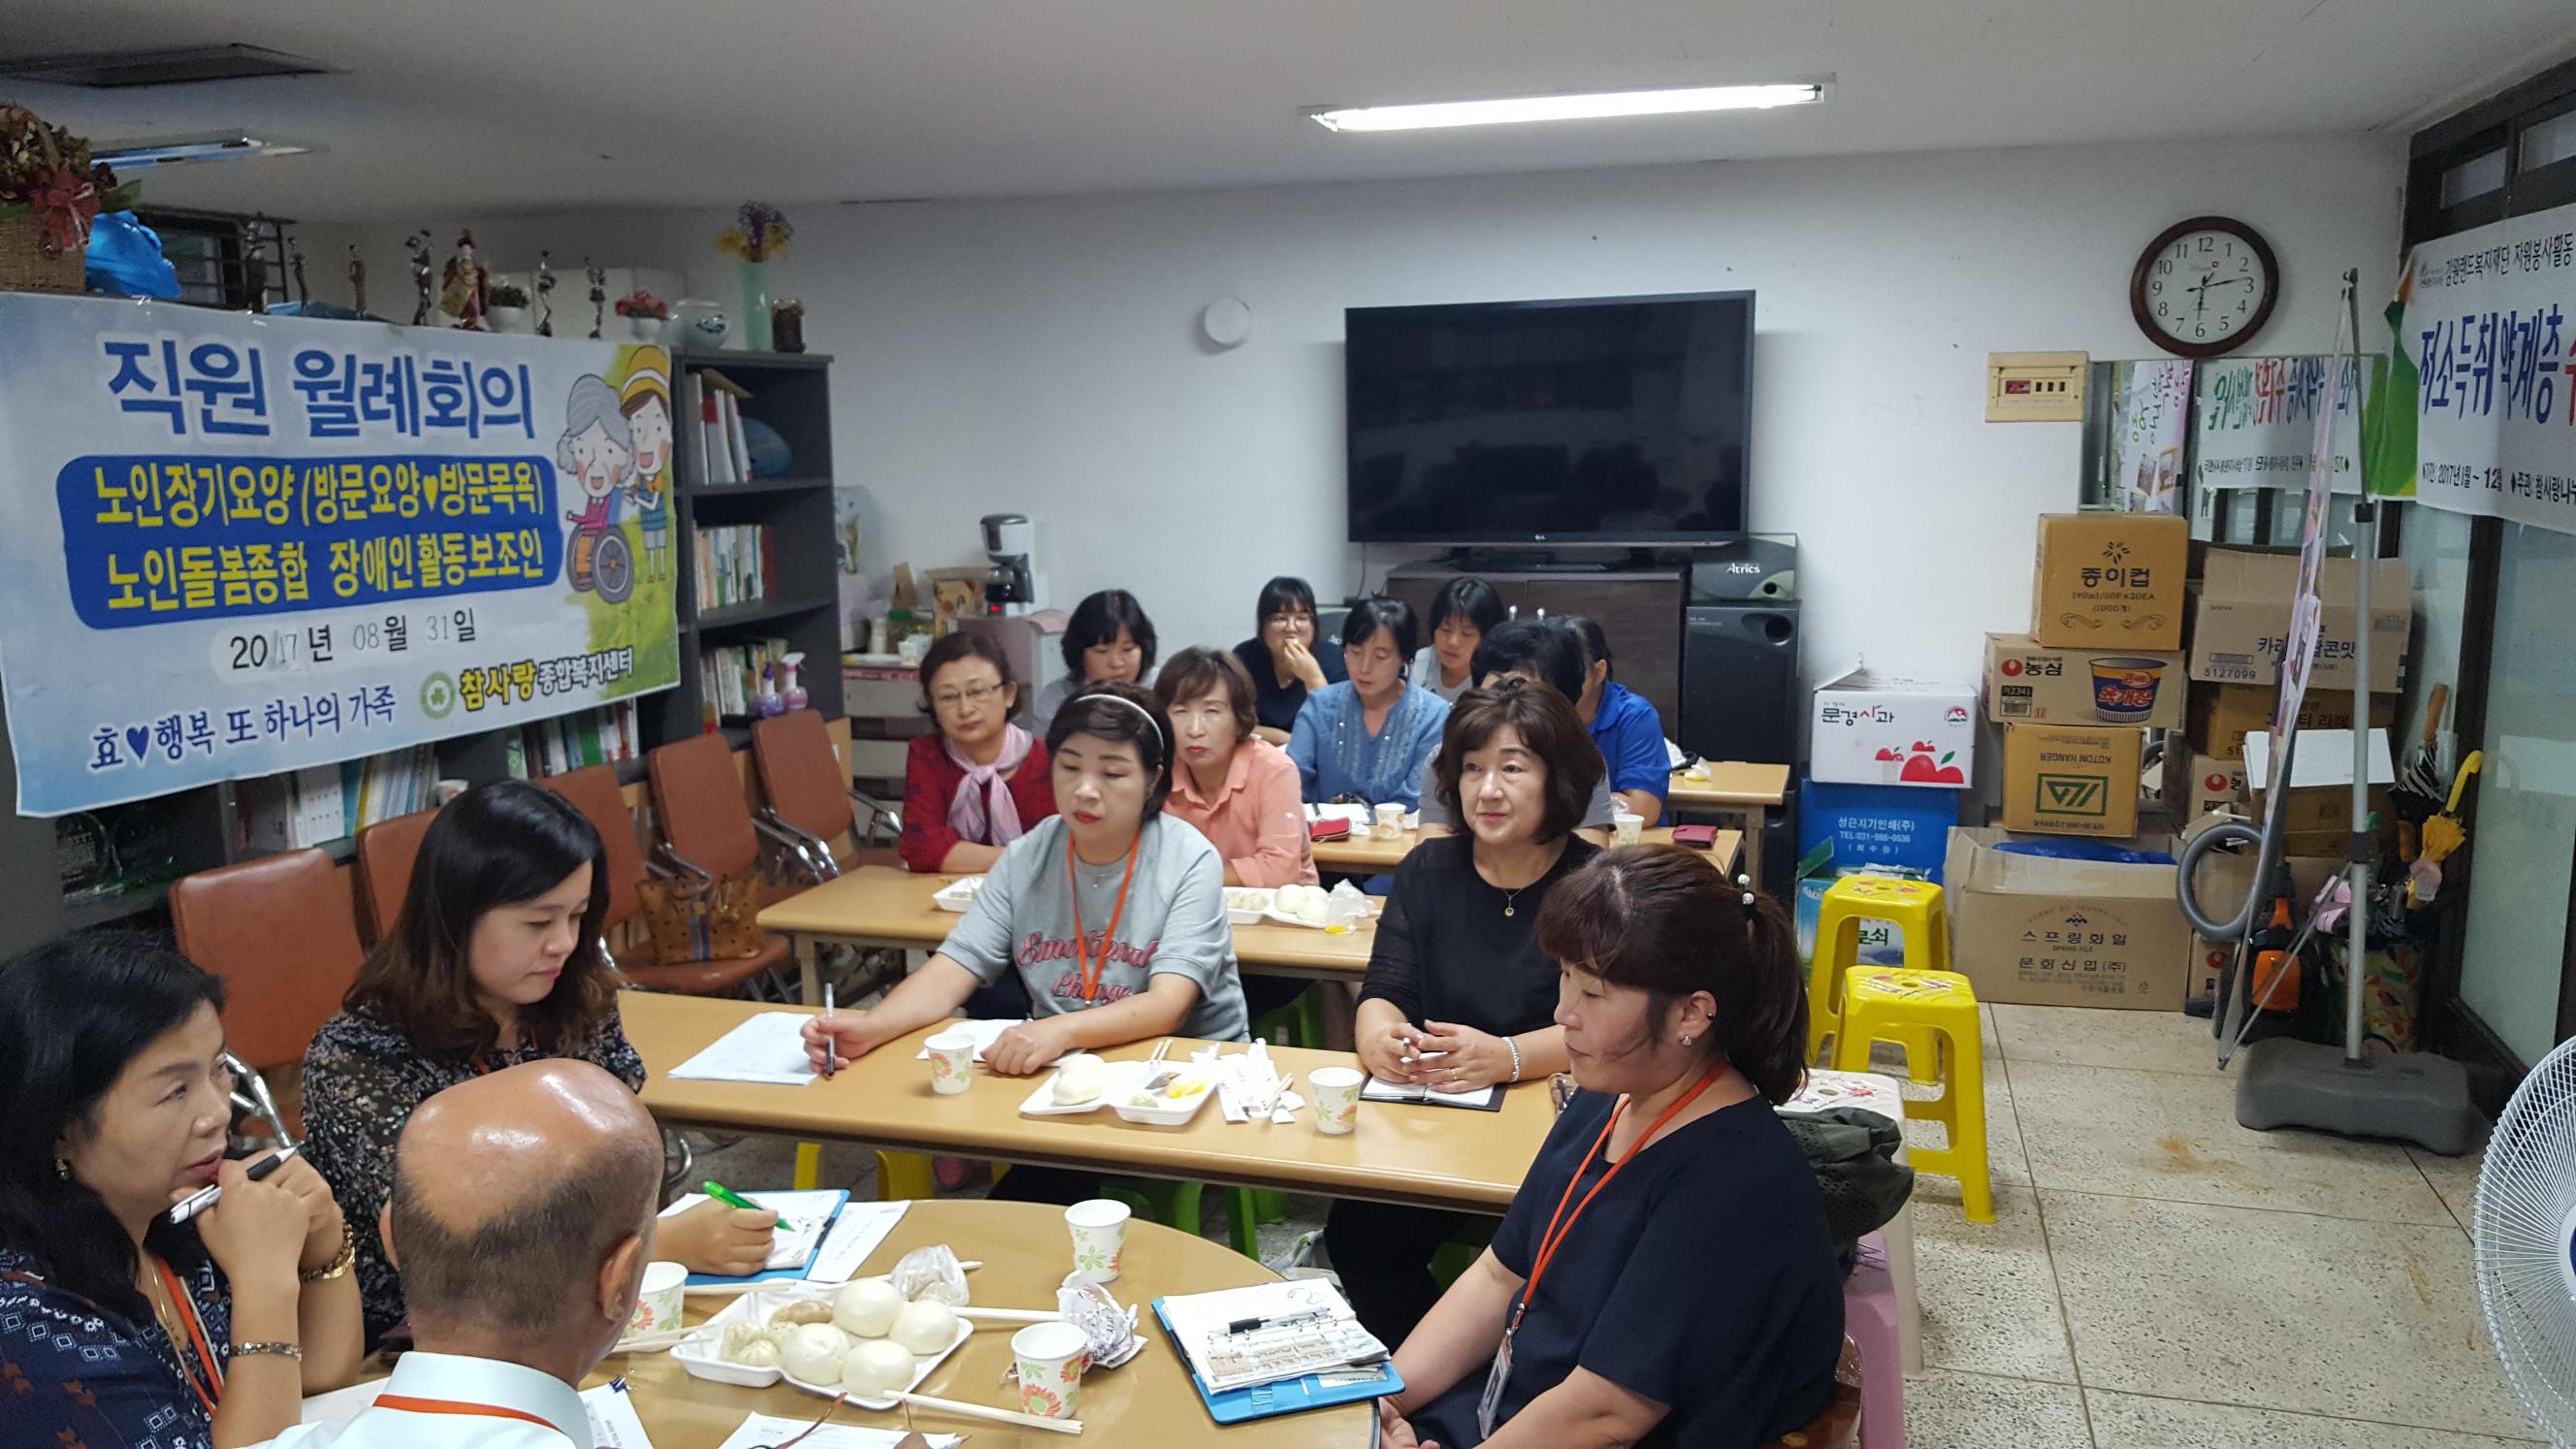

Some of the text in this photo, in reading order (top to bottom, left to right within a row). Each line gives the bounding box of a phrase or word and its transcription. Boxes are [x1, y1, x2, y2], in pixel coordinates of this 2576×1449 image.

[2175, 243, 2188, 259] 11
[2198, 236, 2213, 252] 12
[2225, 242, 2232, 257] 1
[2158, 259, 2173, 275] 10
[2238, 256, 2248, 272] 2
[2152, 280, 2163, 296] 9
[2244, 276, 2254, 293] 3
[2158, 302, 2168, 316] 8
[2237, 299, 2247, 314] 4
[2175, 317, 2185, 333] 7
[2195, 322, 2206, 338] 6
[2219, 316, 2229, 331] 5
[104, 339, 535, 439] 직원 월례회의
[95, 462, 296, 529] 노인장기요양
[108, 540, 309, 612] 노인돌봄종합
[2080, 567, 2150, 588] 종이컵
[2024, 660, 2063, 677] 농심
[2203, 667, 2257, 679] 5127099
[225, 709, 258, 745] 또
[264, 692, 341, 743] 하나의
[348, 684, 397, 727] 가족
[1821, 704, 1895, 727] 문경사과
